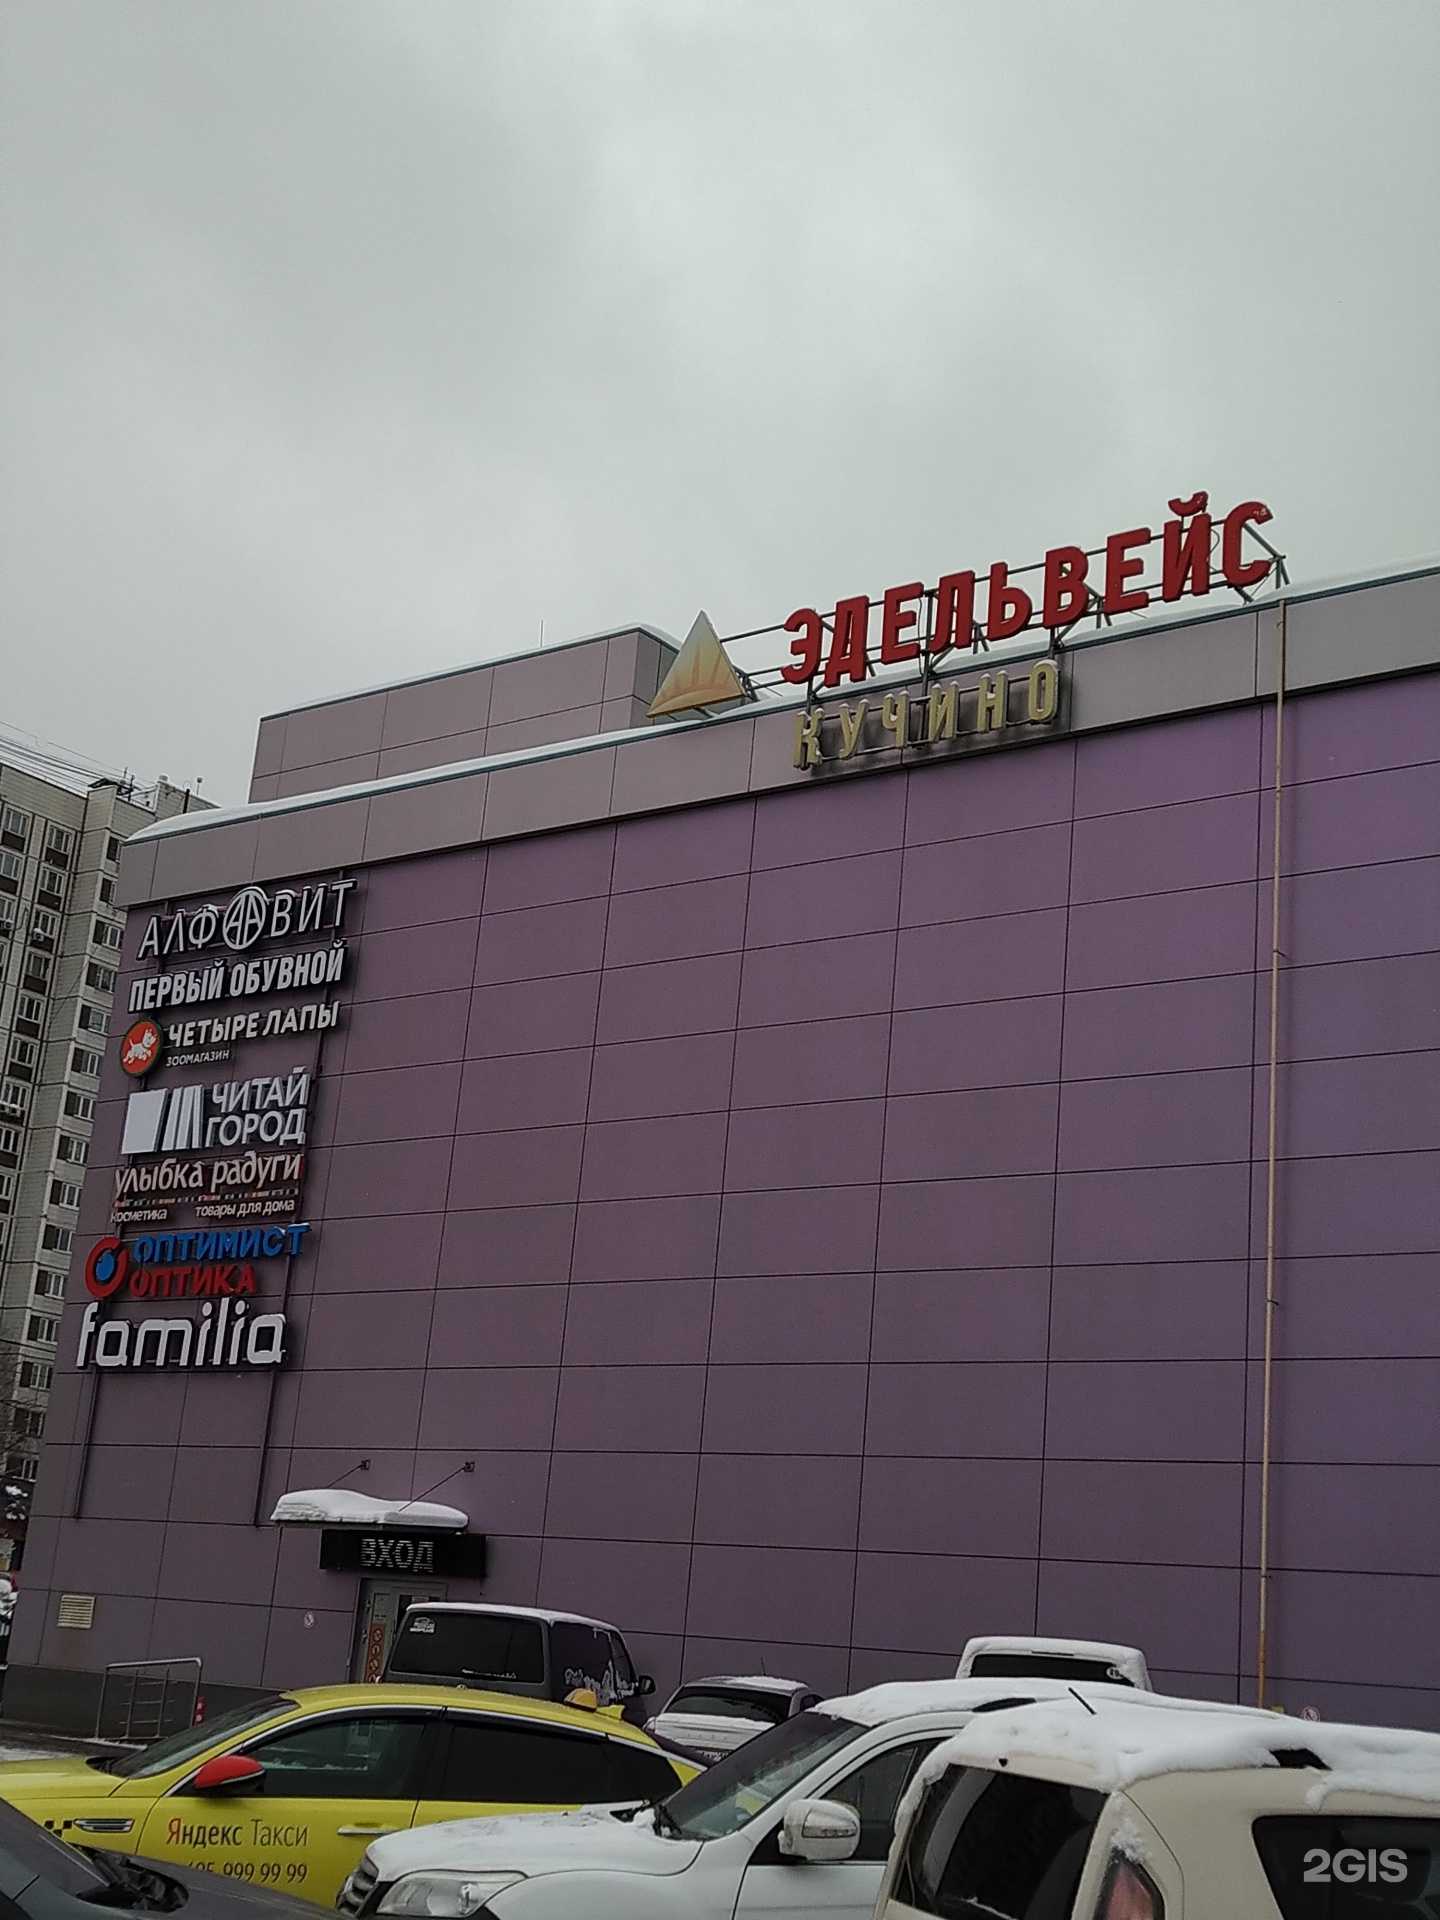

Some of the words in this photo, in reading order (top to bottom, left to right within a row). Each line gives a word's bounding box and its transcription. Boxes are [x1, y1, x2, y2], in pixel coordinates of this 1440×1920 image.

[780, 491, 1274, 688] ЭДЕЛЬВЕЙС
[792, 659, 1060, 770] КУЧИНО
[137, 880, 355, 958] АЛФАВИТ
[128, 961, 225, 1012] ПЕРВЫЙ
[229, 939, 345, 997] ОБУВНОЙ
[168, 1013, 259, 1048] ЧЕТЫРЕ
[262, 1001, 340, 1037] ЛАПЫ
[165, 1049, 231, 1068] ЗООМАГАЗИН
[212, 1067, 309, 1112] ЧИТАЙ
[205, 1109, 305, 1147] ГОРОД
[211, 1150, 304, 1194] радуги
[195, 1203, 236, 1219] товары
[236, 1201, 262, 1218] для
[263, 1199, 295, 1215] дома
[133, 1223, 311, 1263] ОПТИМИСТ
[130, 1263, 256, 1297] ОПТИКА
[76, 1298, 287, 1368] familia
[360, 1538, 434, 1573] ВХОД
[166, 1818, 243, 1849] Яндекс
[250, 1819, 309, 1847] Такси
[260, 1864, 281, 1883] 99
[286, 1864, 308, 1884] 99
